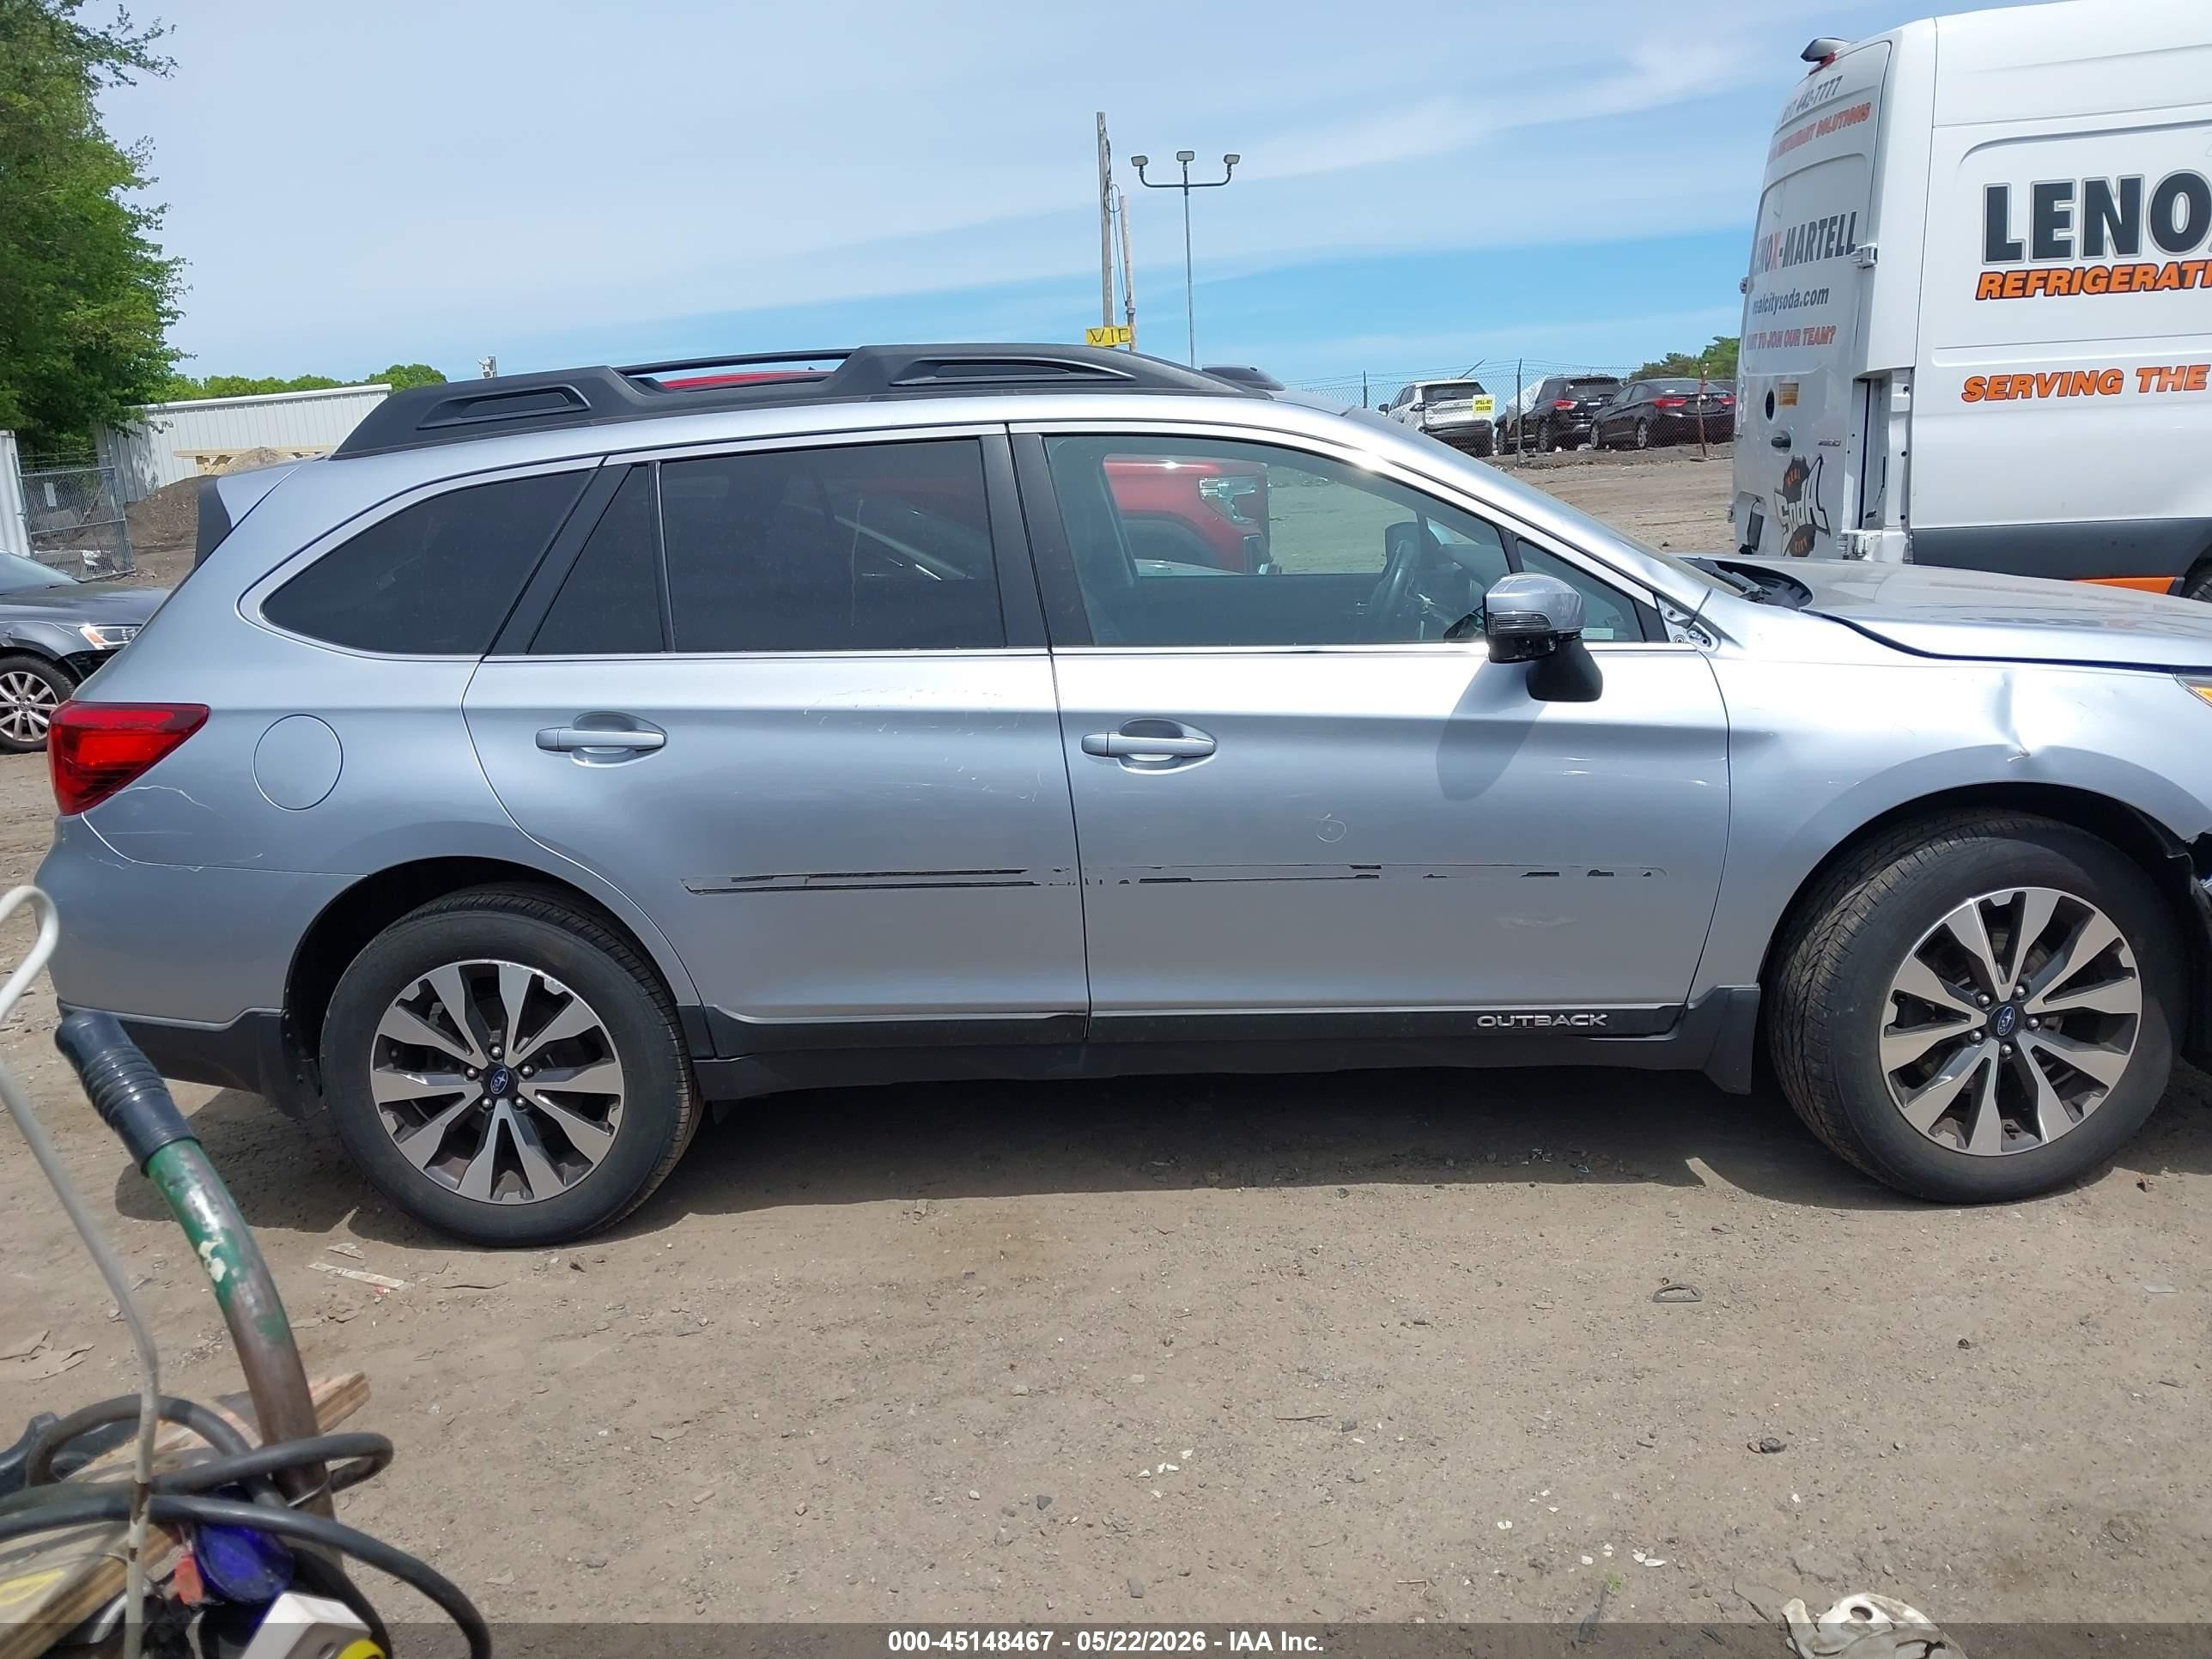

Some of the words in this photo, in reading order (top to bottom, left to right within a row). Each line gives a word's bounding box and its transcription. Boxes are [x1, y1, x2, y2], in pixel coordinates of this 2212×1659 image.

[1815, 101, 1872, 138] SOLUTIONS
[1981, 168, 2212, 265] LENO
[1784, 328, 1802, 348] OUR
[1802, 325, 1837, 346] TEAM?
[1961, 368, 2124, 403] SERVING
[2136, 363, 2211, 393] THE
[1476, 1013, 1608, 1028] OUTBACK
